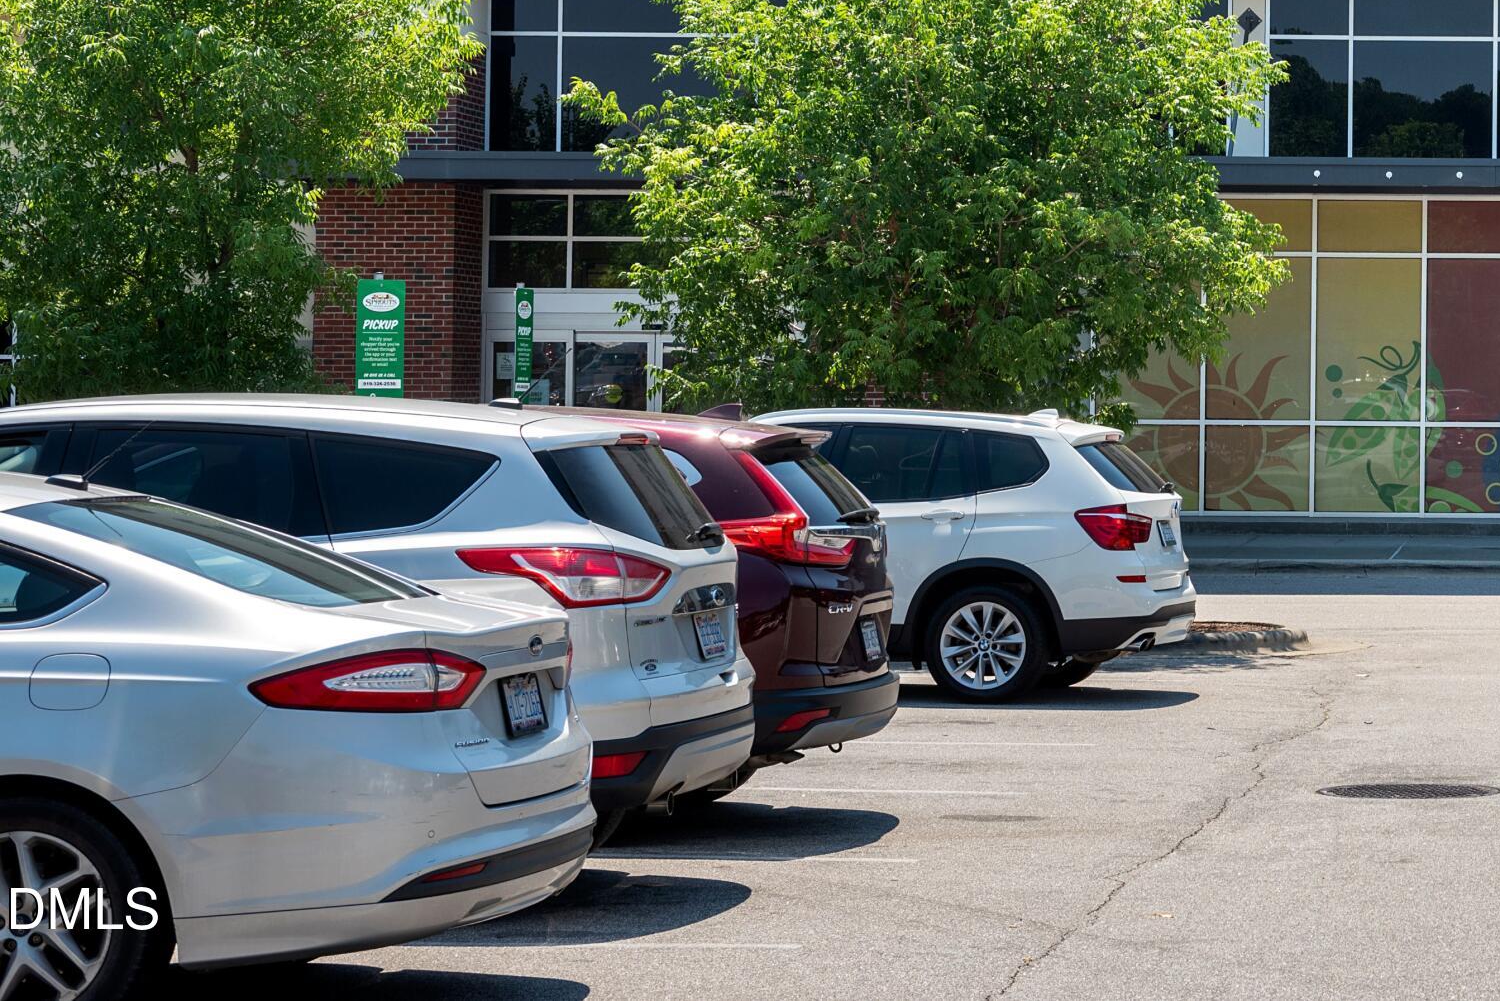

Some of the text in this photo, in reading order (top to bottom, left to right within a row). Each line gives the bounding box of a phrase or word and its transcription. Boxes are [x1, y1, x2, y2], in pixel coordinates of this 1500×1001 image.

[362, 319, 399, 330] PICKUP
[517, 326, 532, 336] PICKUP
[828, 603, 853, 614] CR-V
